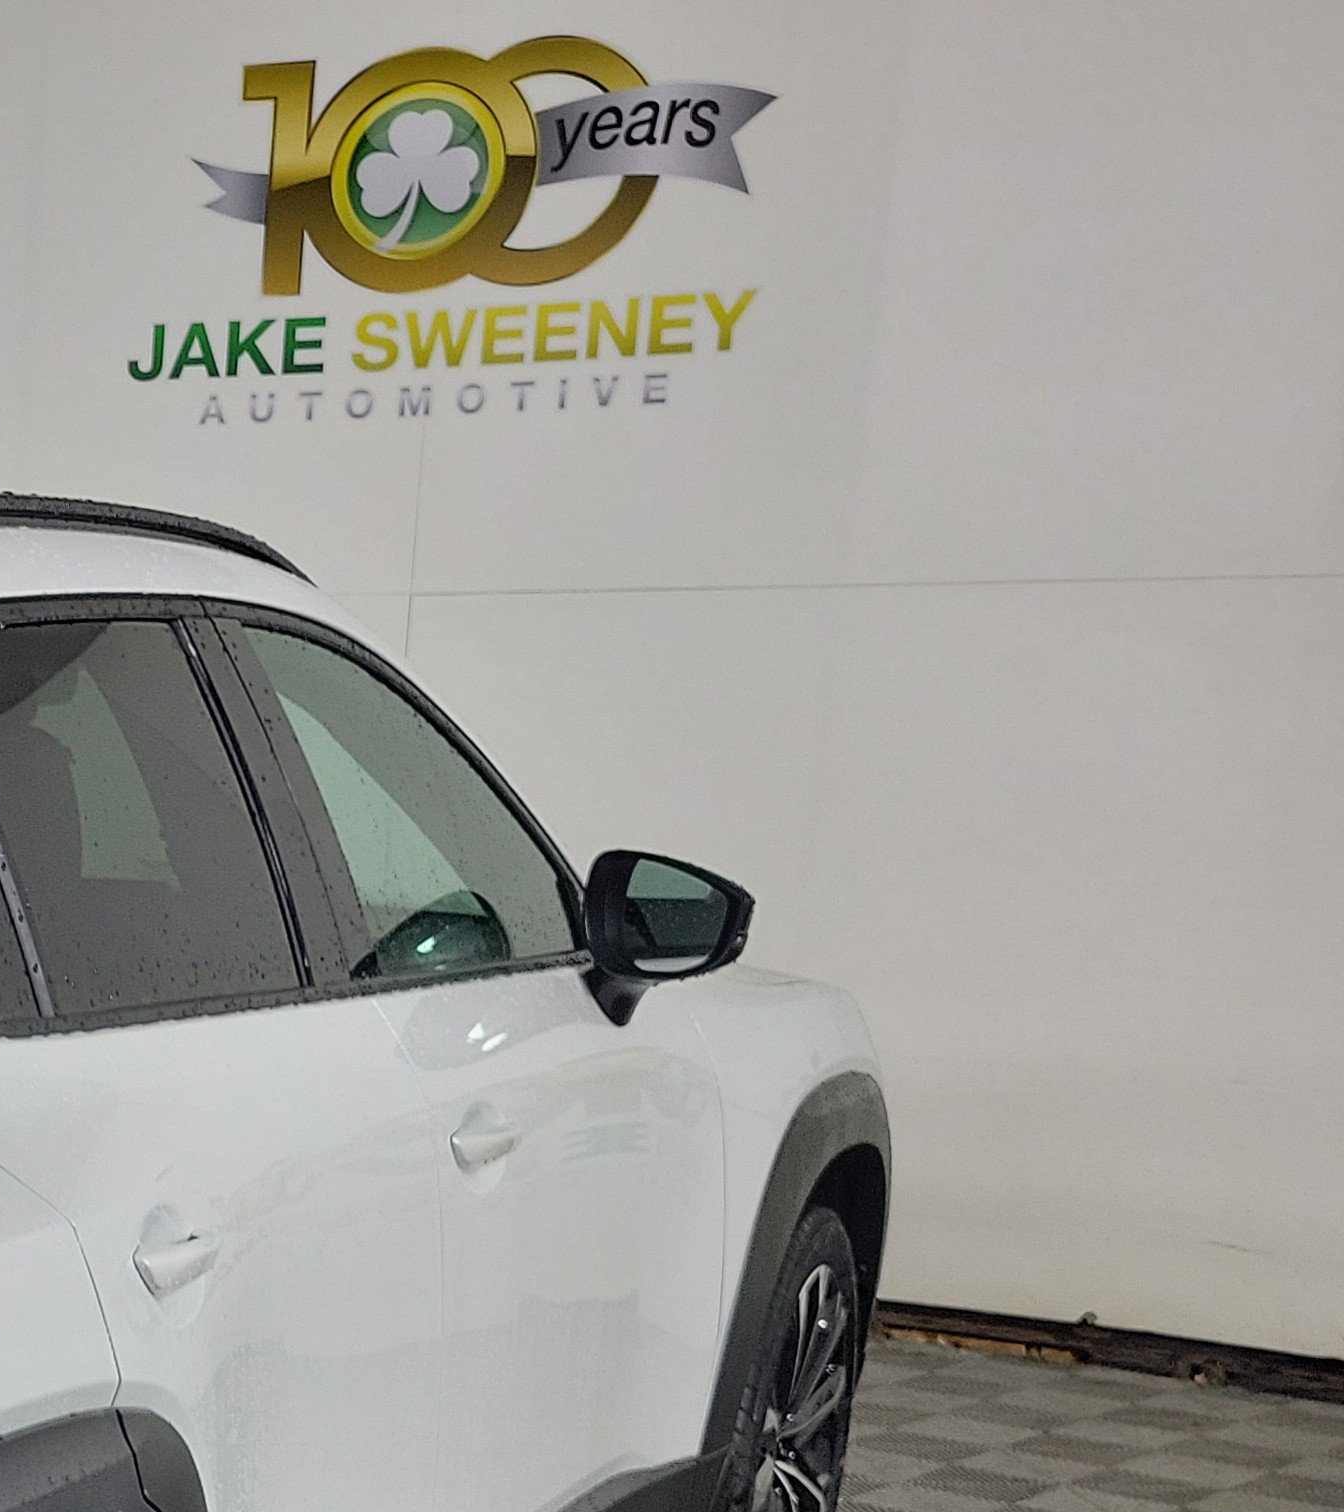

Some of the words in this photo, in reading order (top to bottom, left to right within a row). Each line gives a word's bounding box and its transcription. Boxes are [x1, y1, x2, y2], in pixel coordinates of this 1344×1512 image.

[242, 34, 660, 296] 100
[550, 96, 721, 175] years
[127, 315, 328, 382] JAKE
[350, 289, 759, 373] SWEENEY
[198, 372, 672, 426] AUTOMOTIVE
